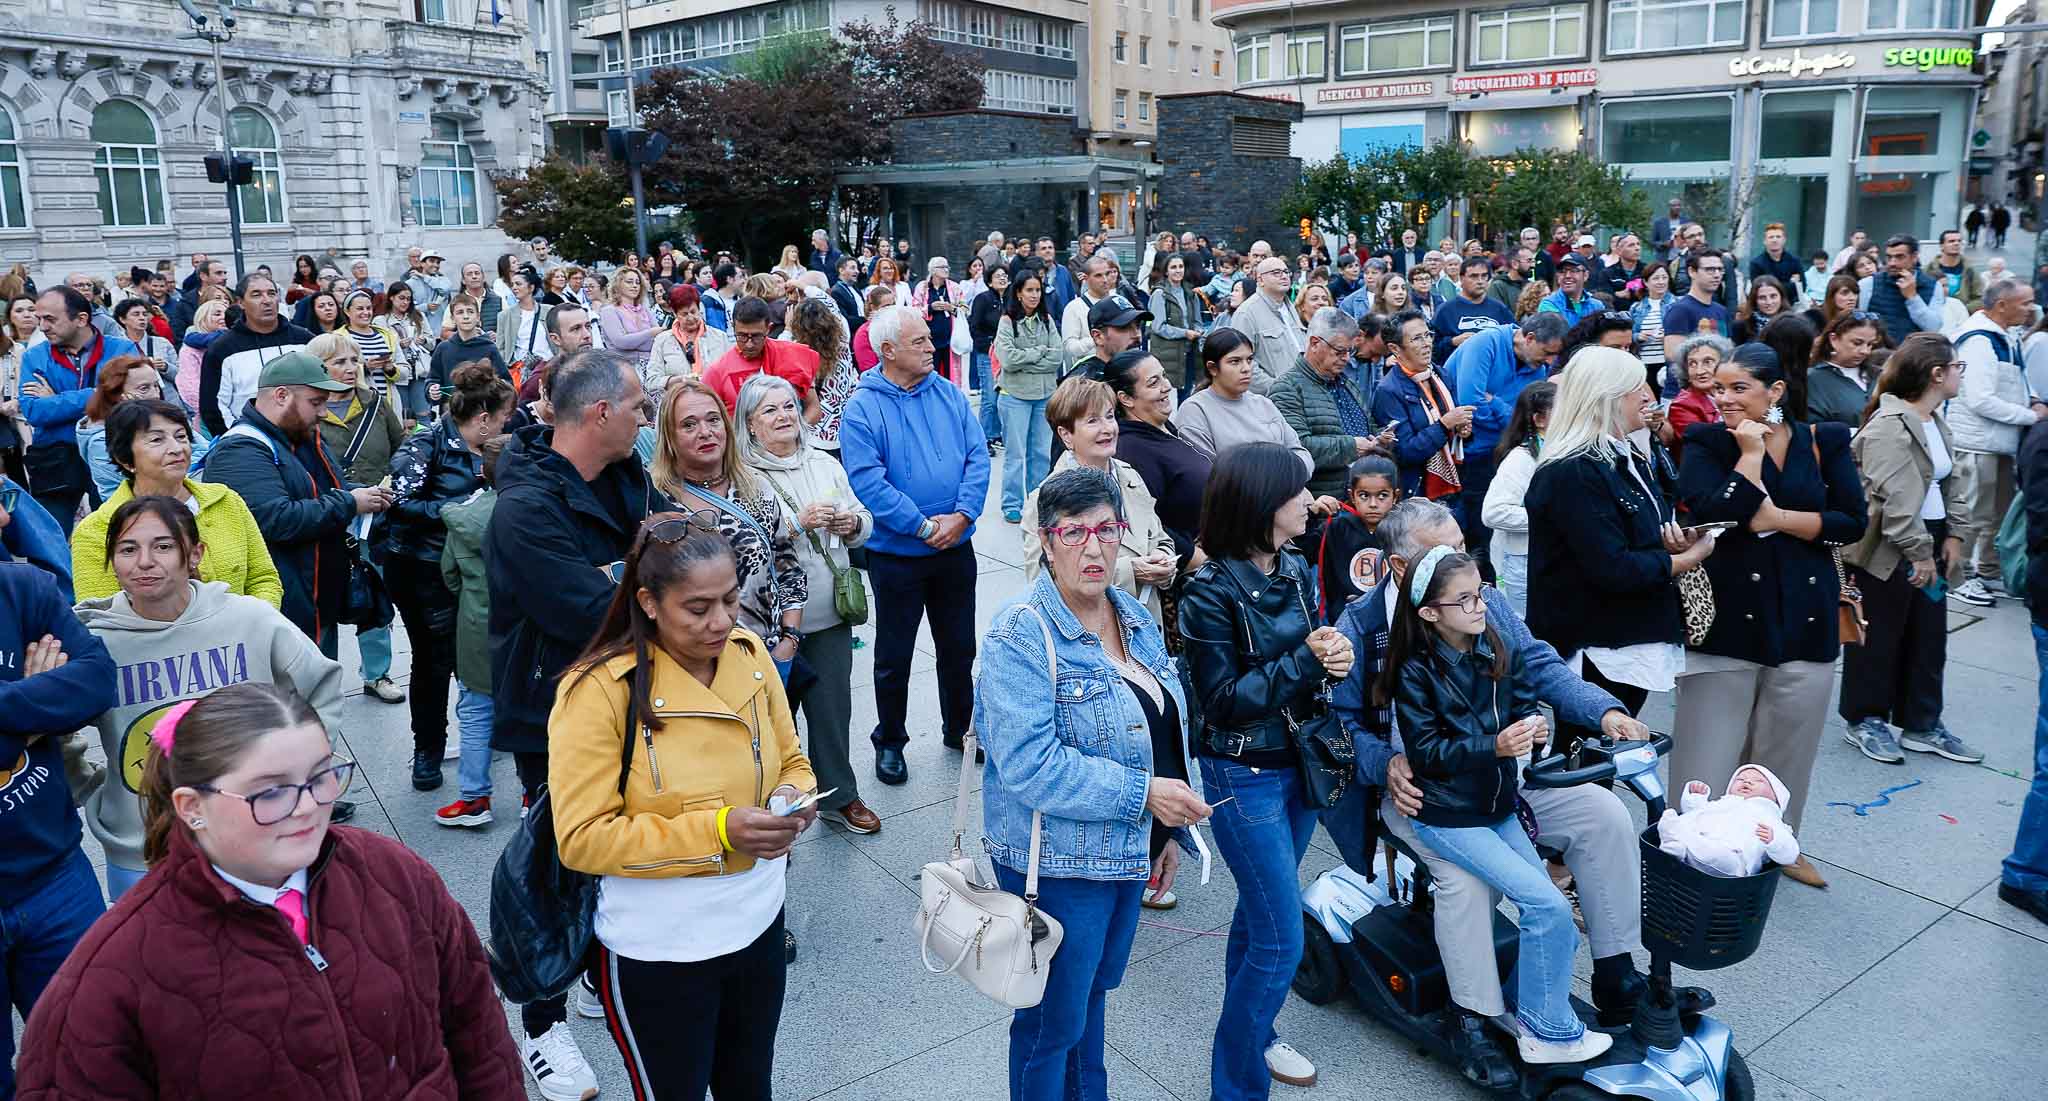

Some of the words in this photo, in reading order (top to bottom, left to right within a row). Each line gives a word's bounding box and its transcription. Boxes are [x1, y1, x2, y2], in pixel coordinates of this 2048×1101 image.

[1885, 47, 1973, 71] seguros
[1319, 88, 1362, 101] AGENCIA
[1365, 87, 1380, 98] DE
[1382, 83, 1432, 97] ADUANAS
[1452, 74, 1536, 91] CONSIGNATARIOS
[1540, 72, 1553, 86] DE
[4, 766, 49, 811] STUPID
